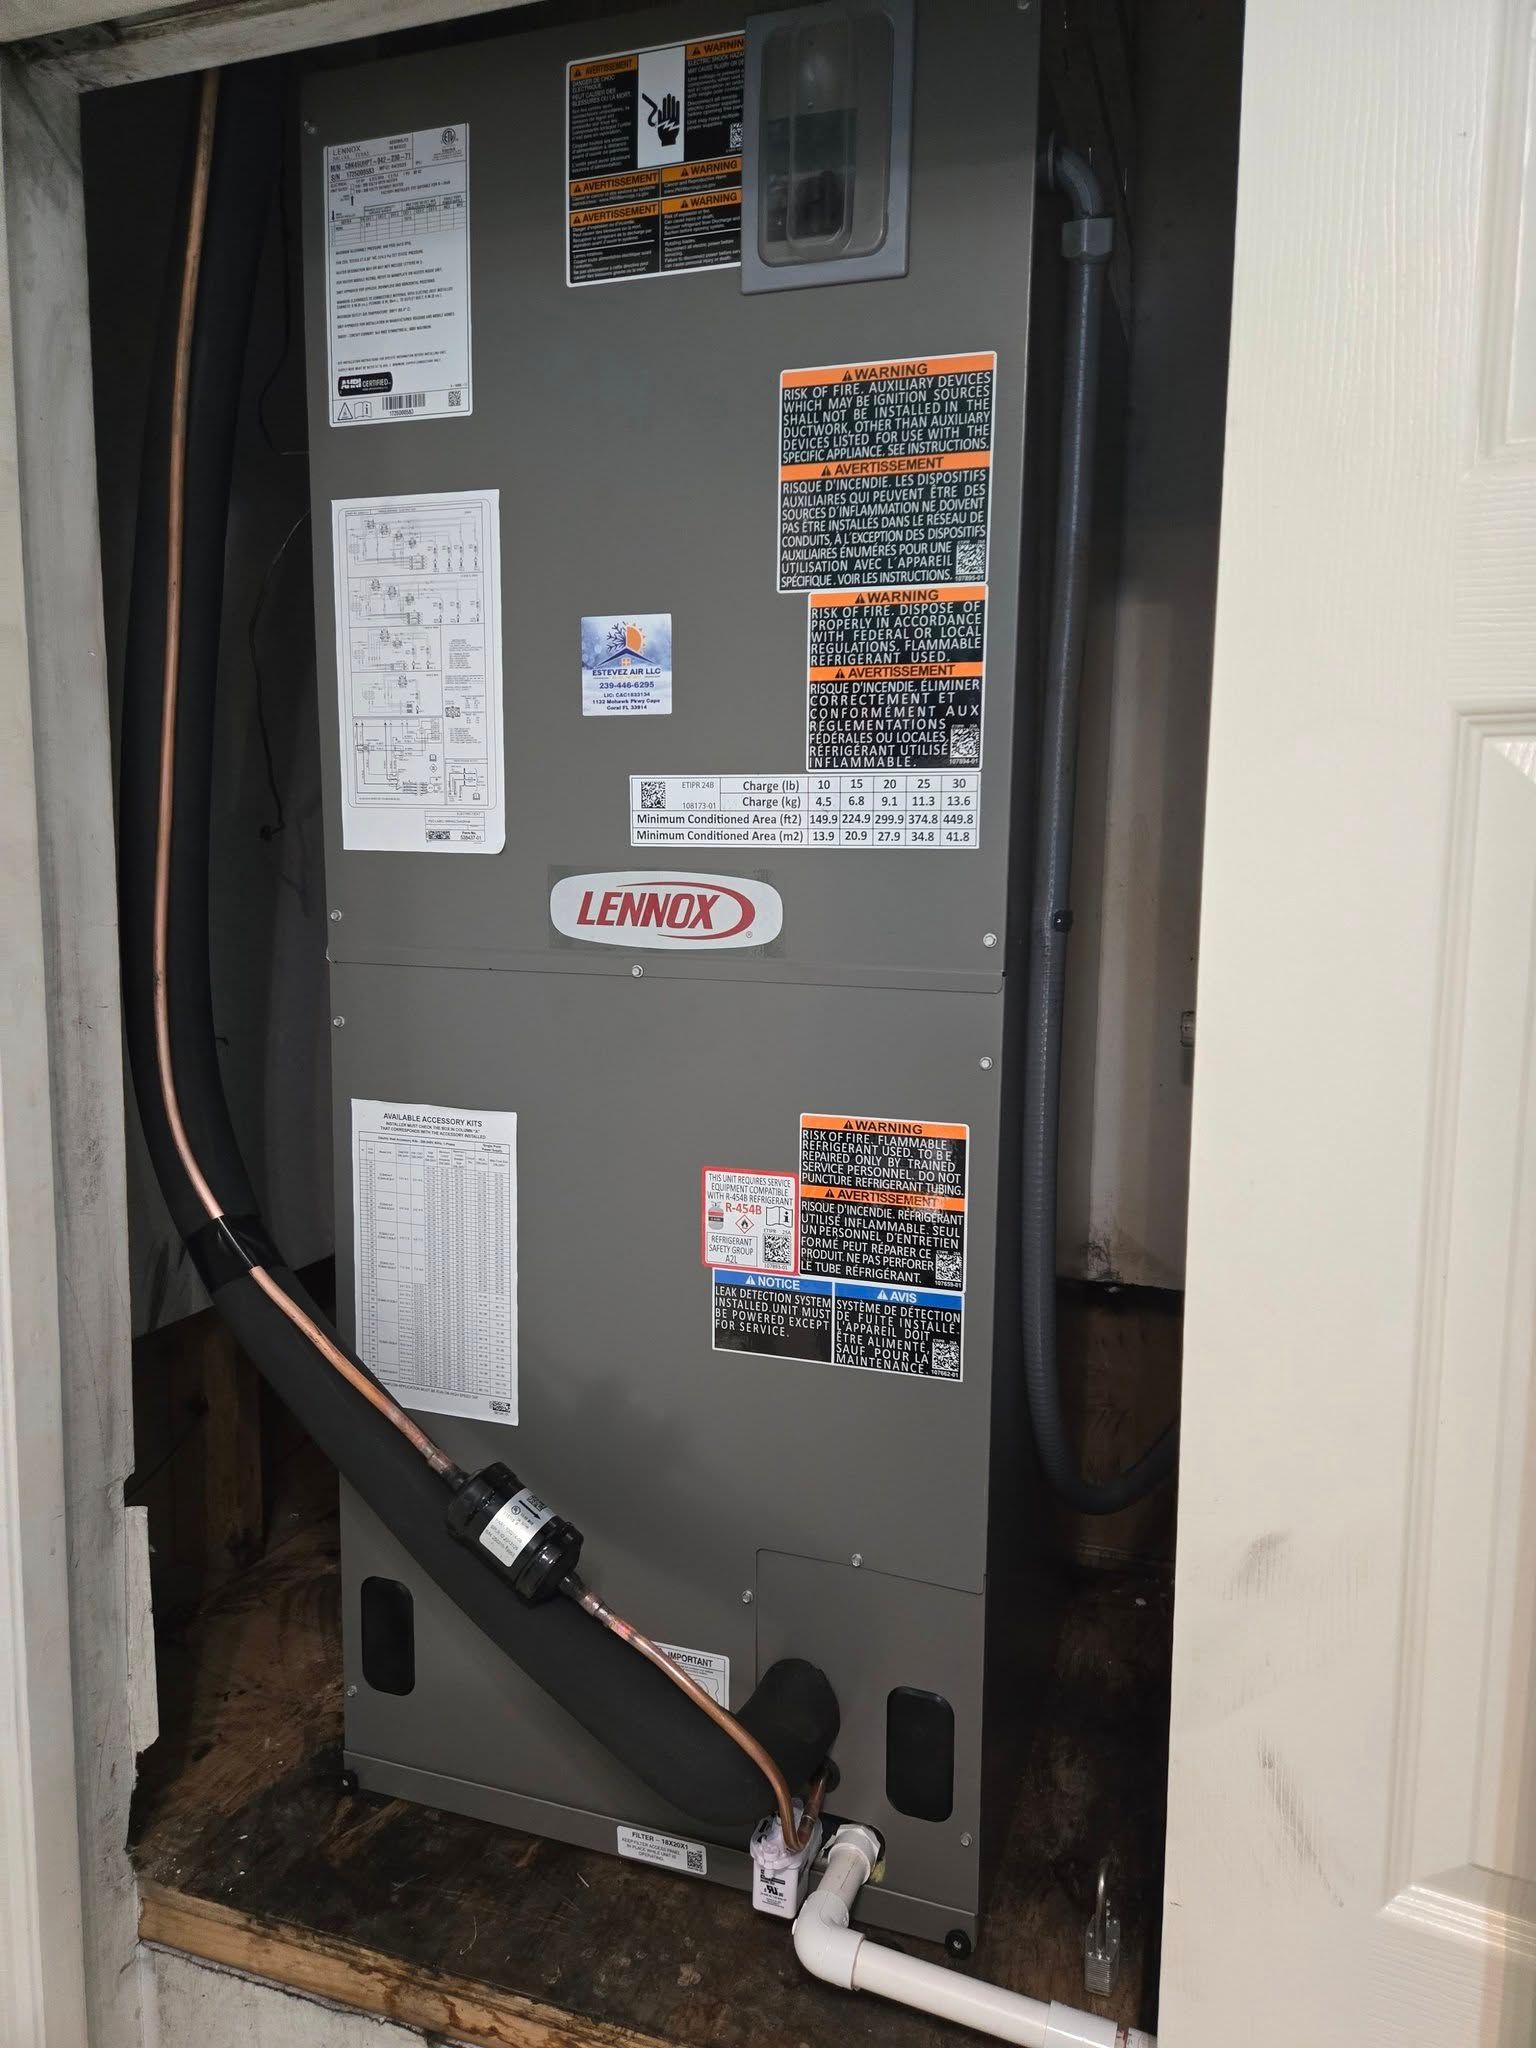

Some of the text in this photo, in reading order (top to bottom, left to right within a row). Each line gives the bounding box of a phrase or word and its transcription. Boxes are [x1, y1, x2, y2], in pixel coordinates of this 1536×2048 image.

[704, 38, 745, 53] WARNIN
[586, 59, 632, 75] AVERTISSEMENT
[333, 145, 360, 156] LENNOX
[691, 160, 737, 175] WARNING
[584, 174, 658, 192] AVERTISSEMENT
[691, 192, 737, 207] WARNING
[583, 204, 657, 222] AVERTISSEMENT
[855, 363, 928, 380] WARNING
[784, 372, 991, 400] RISK OF FIRE. AUXILIARY DEVICES
[784, 386, 989, 413] WHICH MAY BE IGNITION SOURCES
[784, 399, 989, 426] SHALL NOT BE INSTALLED IN THE
[784, 412, 990, 438] DUCTWORK, OTHER THAN AUXILIARY
[784, 424, 989, 451] DEVICES LISTED FOR USE WITH THE
[783, 438, 989, 464] SPECIFIC APPLIANCE. SEE INSTRUCTIONS.
[835, 457, 944, 475] AVERTISSEMENT
[868, 590, 938, 603] WARNING
[812, 602, 980, 619] RISK OF FIRE. DISPOSE OF
[811, 613, 981, 631] PROPERLY IN ACCORDANCE
[811, 626, 981, 642] WITH FEDERAL OR LOCAL
[811, 638, 981, 654] REGULATIONS. FLAMMABLE
[811, 651, 950, 666] REFRIGERANT USED.
[848, 665, 955, 678] AVERTISSEMENT
[743, 778, 966, 793] Charge (lb) 10 15 20 25 30
[743, 796, 970, 809] Charge (kg) 4.5 6.8 9.1 11.3 13.6
[637, 814, 973, 826] Minimum Conditioned Area (ft2) 149.9 224.9 299.9 374.8 449.8
[637, 830, 969, 842] Minimum Conditioned Area (m2) 13.9 20.9 27.9 34.8 41.8
[577, 891, 720, 929] LENNOX
[384, 1113, 420, 1122] AVAILABLE
[422, 1116, 464, 1126] ACCESSORY
[856, 1120, 922, 1135] WARNING
[709, 1173, 721, 1181] THIS
[738, 1176, 766, 1185] REQUIRES
[768, 1178, 790, 1188] SERVICE
[712, 1183, 788, 1197] EQUIPMENT COMPATIBLE
[708, 1192, 793, 1206] WITH R-454B REFRIGERANT
[838, 1189, 937, 1207] AVERTISSEMENT
[726, 1203, 762, 1215] R-454B
[712, 1235, 752, 1246] REFRIGERANT
[709, 1243, 753, 1255] SAFETY GROUP
[726, 1255, 737, 1264] A2L
[758, 1276, 800, 1290] NOTICE
[716, 1286, 831, 1308] LEAK DETECTION SYSTEM
[890, 1291, 917, 1304] AVIS
[716, 1308, 829, 1330] BE POWERED EXCEPT
[773, 1304, 798, 1315] UNIT
[802, 1307, 830, 1319] MUST
[716, 1319, 789, 1338] FOR SERVICE.
[632, 1832, 654, 1841] FILTER
